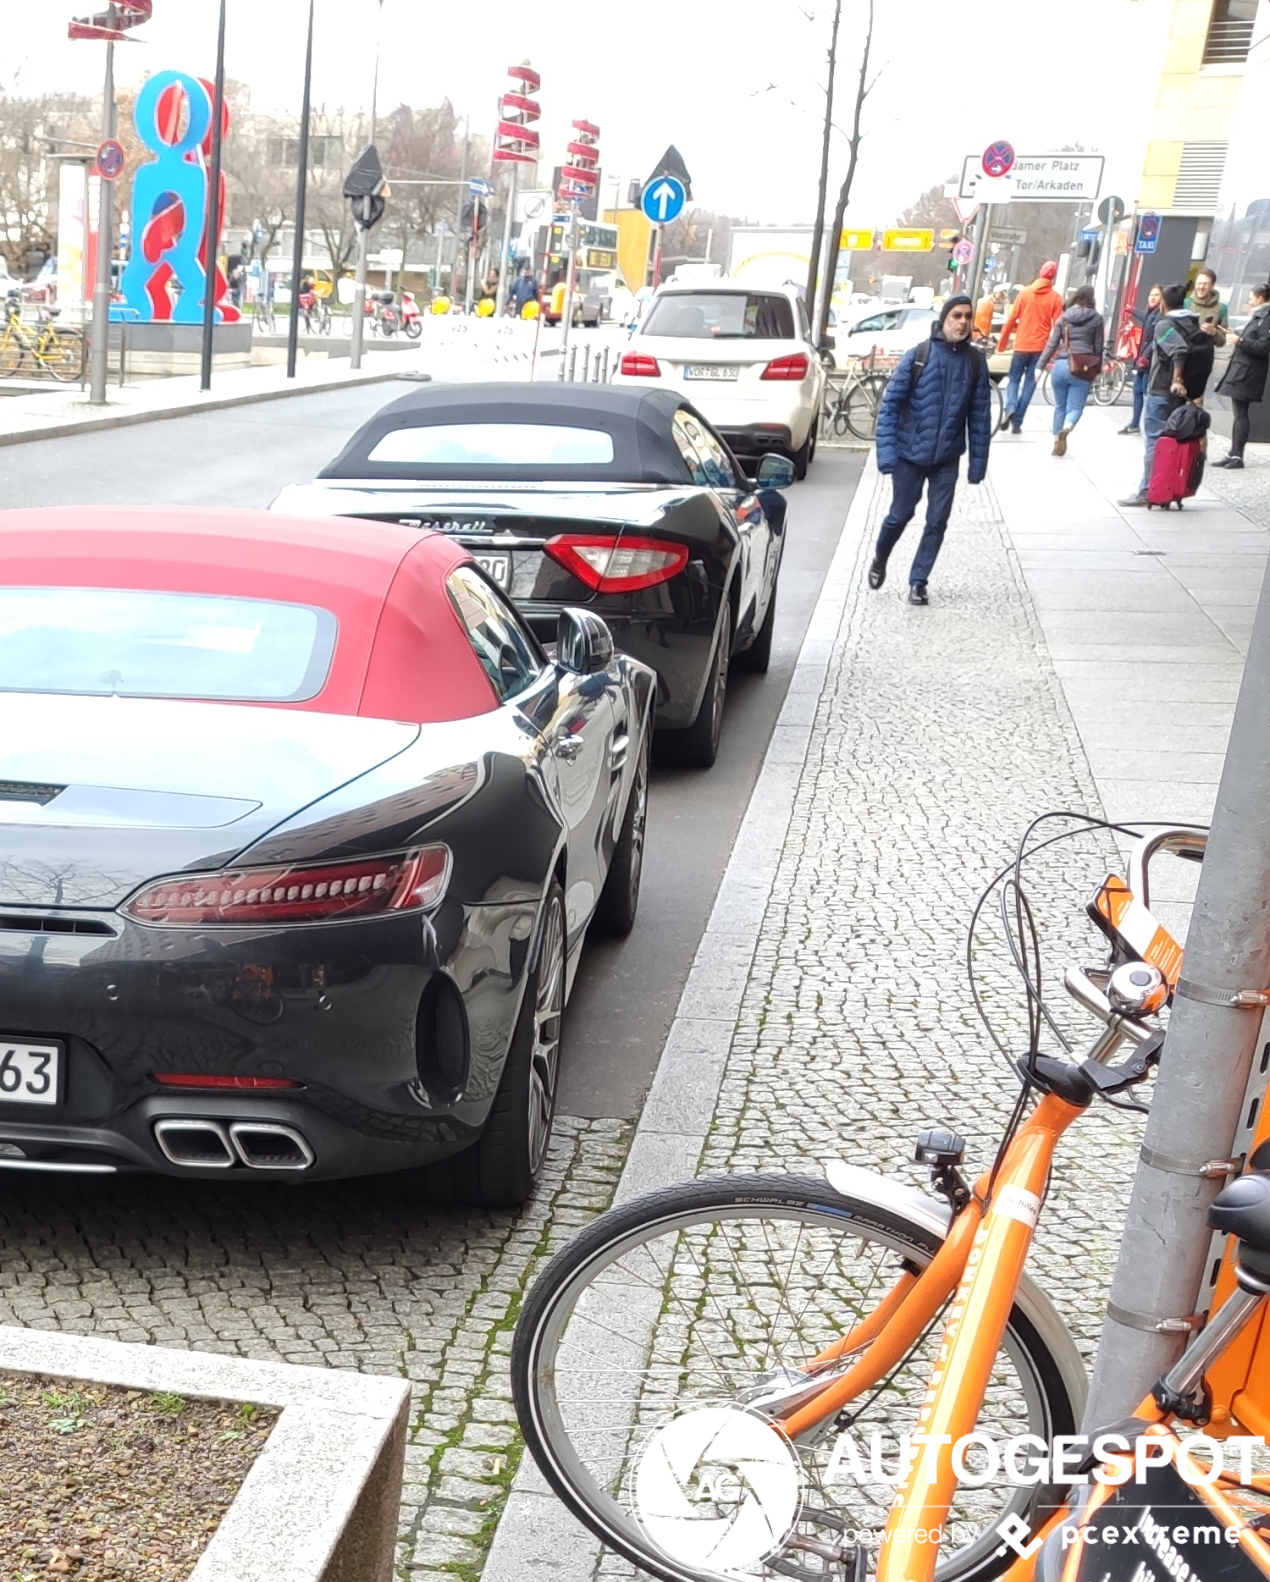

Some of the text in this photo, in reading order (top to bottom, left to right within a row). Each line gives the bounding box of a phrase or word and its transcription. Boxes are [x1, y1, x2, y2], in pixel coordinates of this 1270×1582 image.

[1013, 160, 1080, 171] damer Platz
[1016, 179, 1083, 191] Tor/Arkaden
[1138, 240, 1156, 249] TAXI
[734, 1196, 804, 1207] SCHWALBE
[854, 1214, 915, 1243] MARATHON
